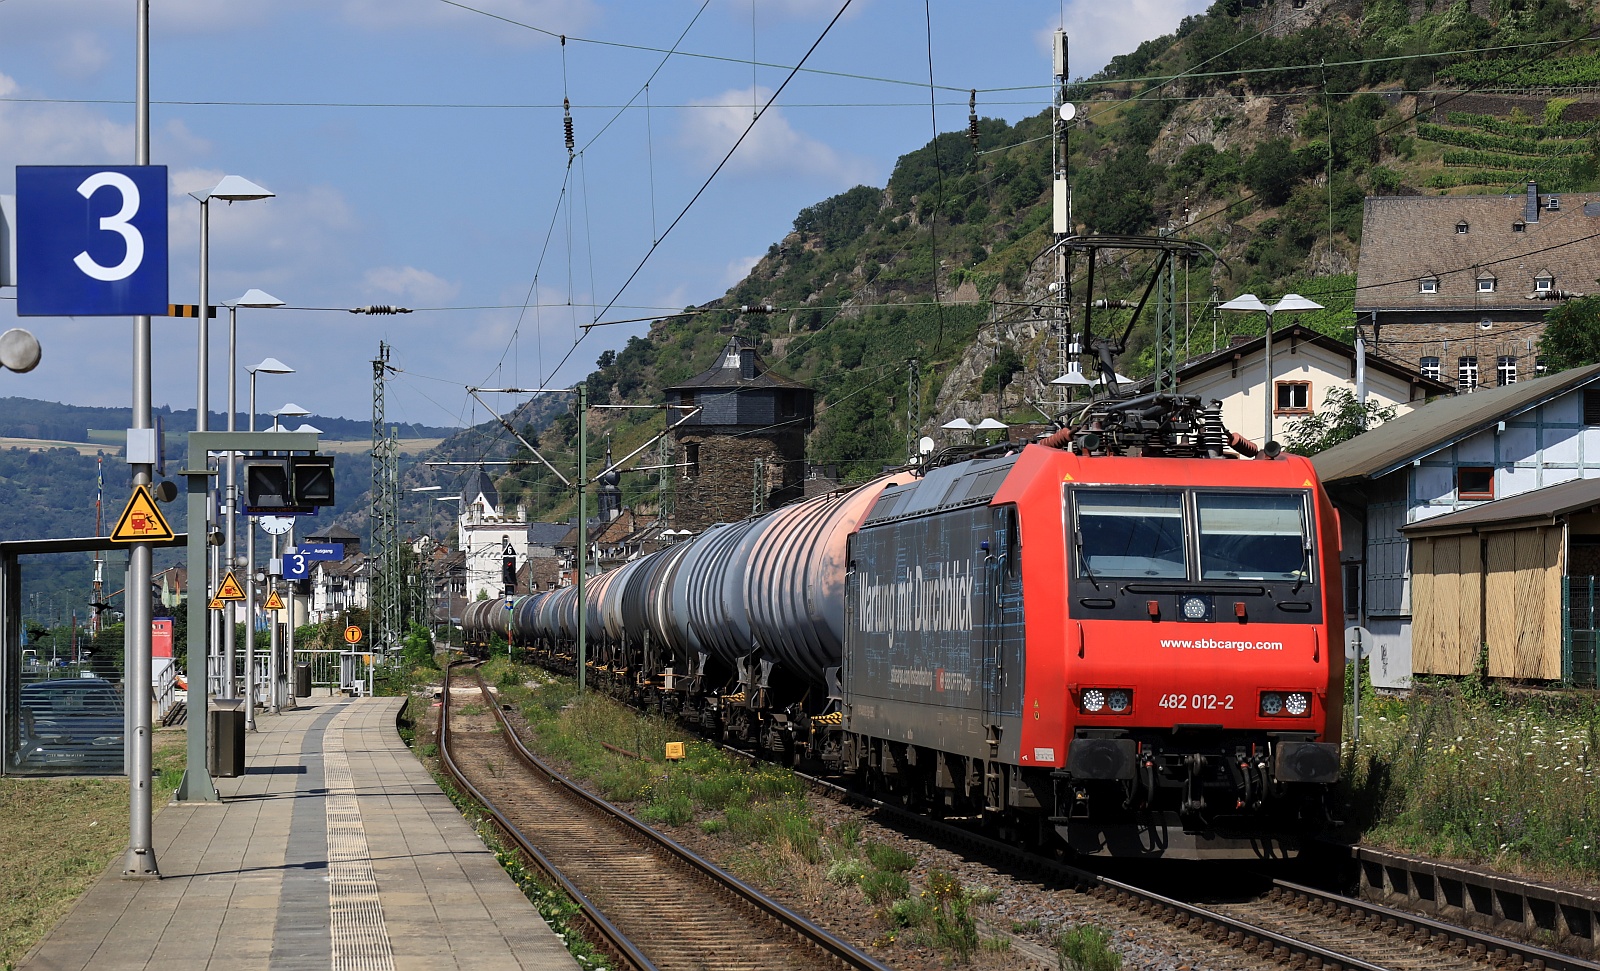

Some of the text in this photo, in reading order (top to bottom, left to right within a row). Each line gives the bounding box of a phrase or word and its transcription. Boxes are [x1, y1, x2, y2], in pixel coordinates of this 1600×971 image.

[73, 171, 145, 282] 3
[508, 546, 512, 554] 6
[291, 555, 305, 574] 3
[859, 558, 974, 648] Wartung mit Durchblick
[1160, 638, 1283, 652] www.sbbcargo.com
[1159, 694, 1234, 709] 482 012-2
